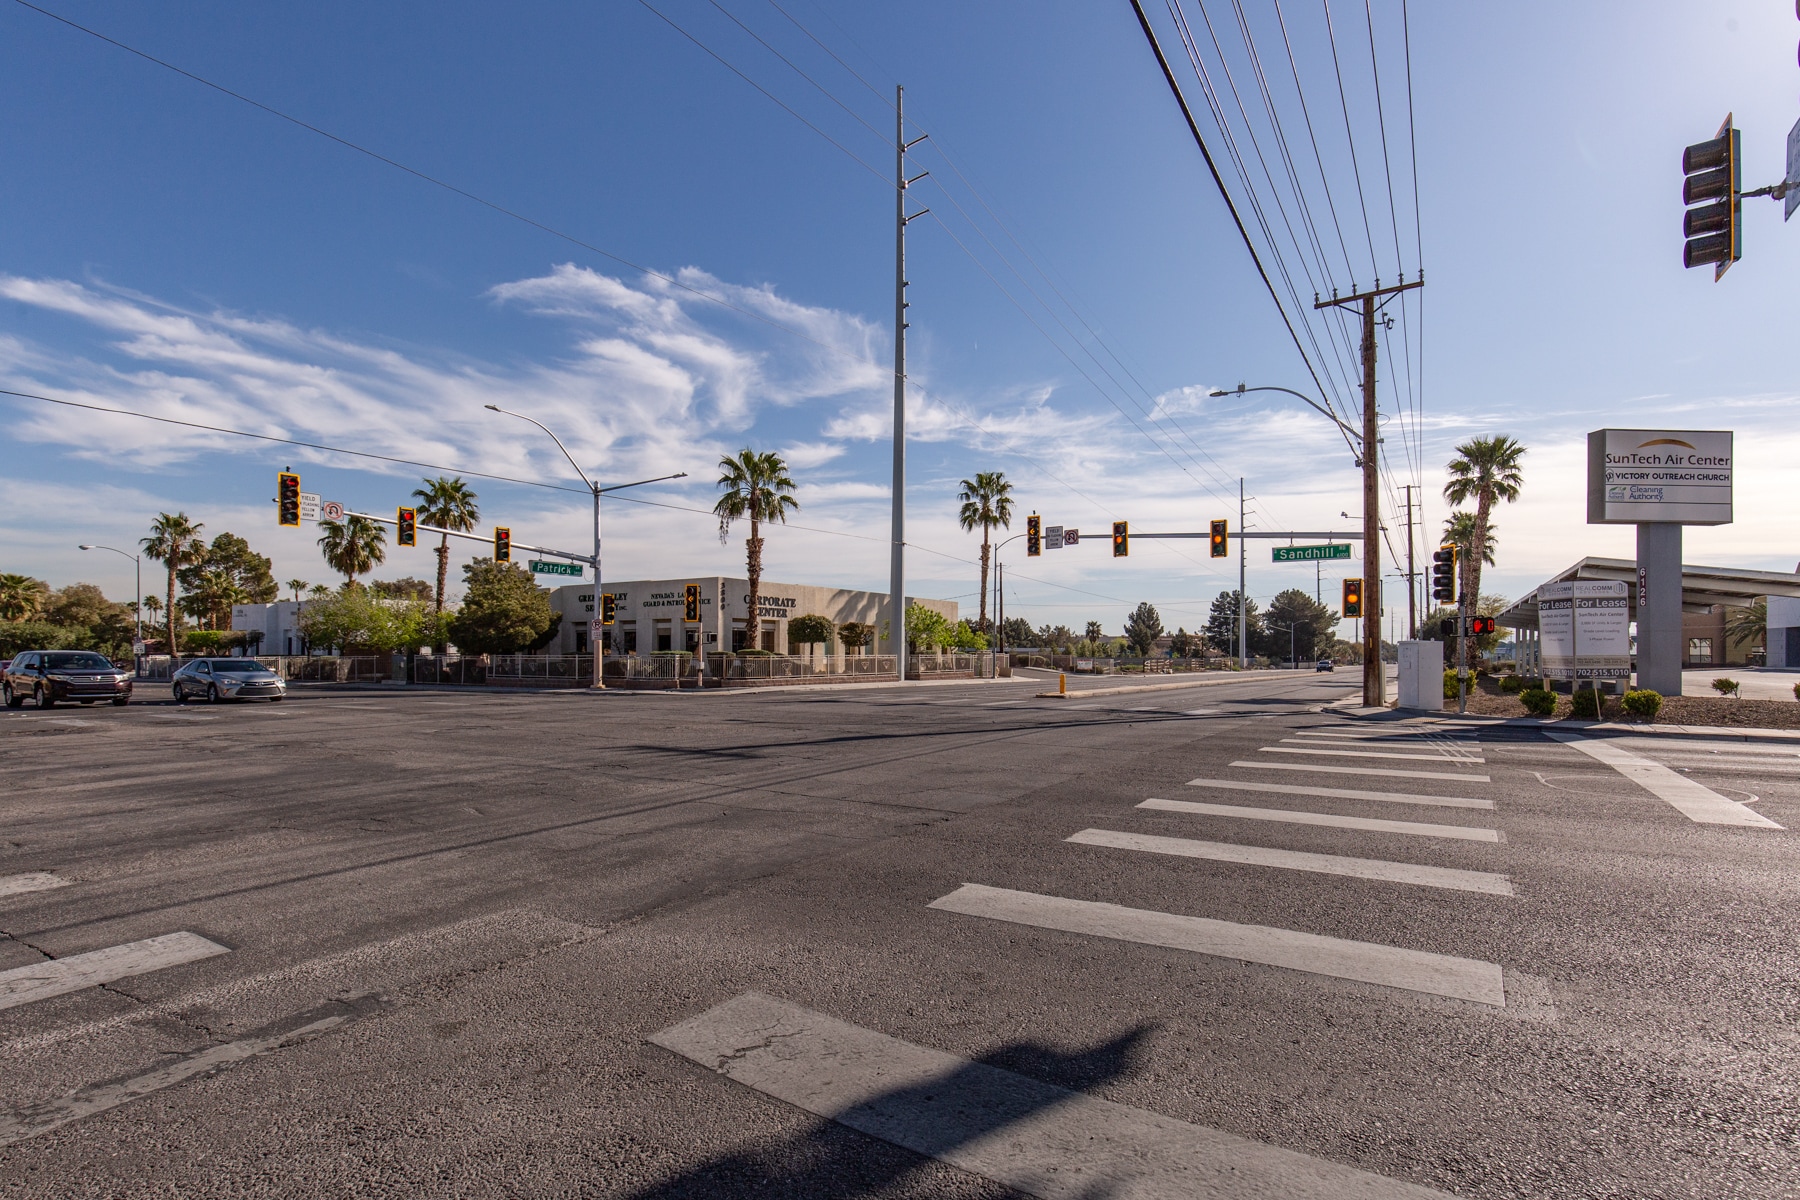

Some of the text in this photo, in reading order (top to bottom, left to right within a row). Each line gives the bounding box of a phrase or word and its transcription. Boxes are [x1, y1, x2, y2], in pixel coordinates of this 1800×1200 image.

[1606, 453, 1730, 466] SunTech Air Center
[1615, 472, 1650, 480] VICTORY
[1652, 472, 1696, 480] OUTREACH
[1630, 485, 1663, 494] Cleaning
[1280, 548, 1334, 560] Sandhill
[538, 563, 571, 574] Patrick
[744, 594, 796, 608] CRPORATE
[1539, 602, 1550, 610] For
[1576, 599, 1626, 608] For Lease
[757, 607, 788, 618] ENTER
